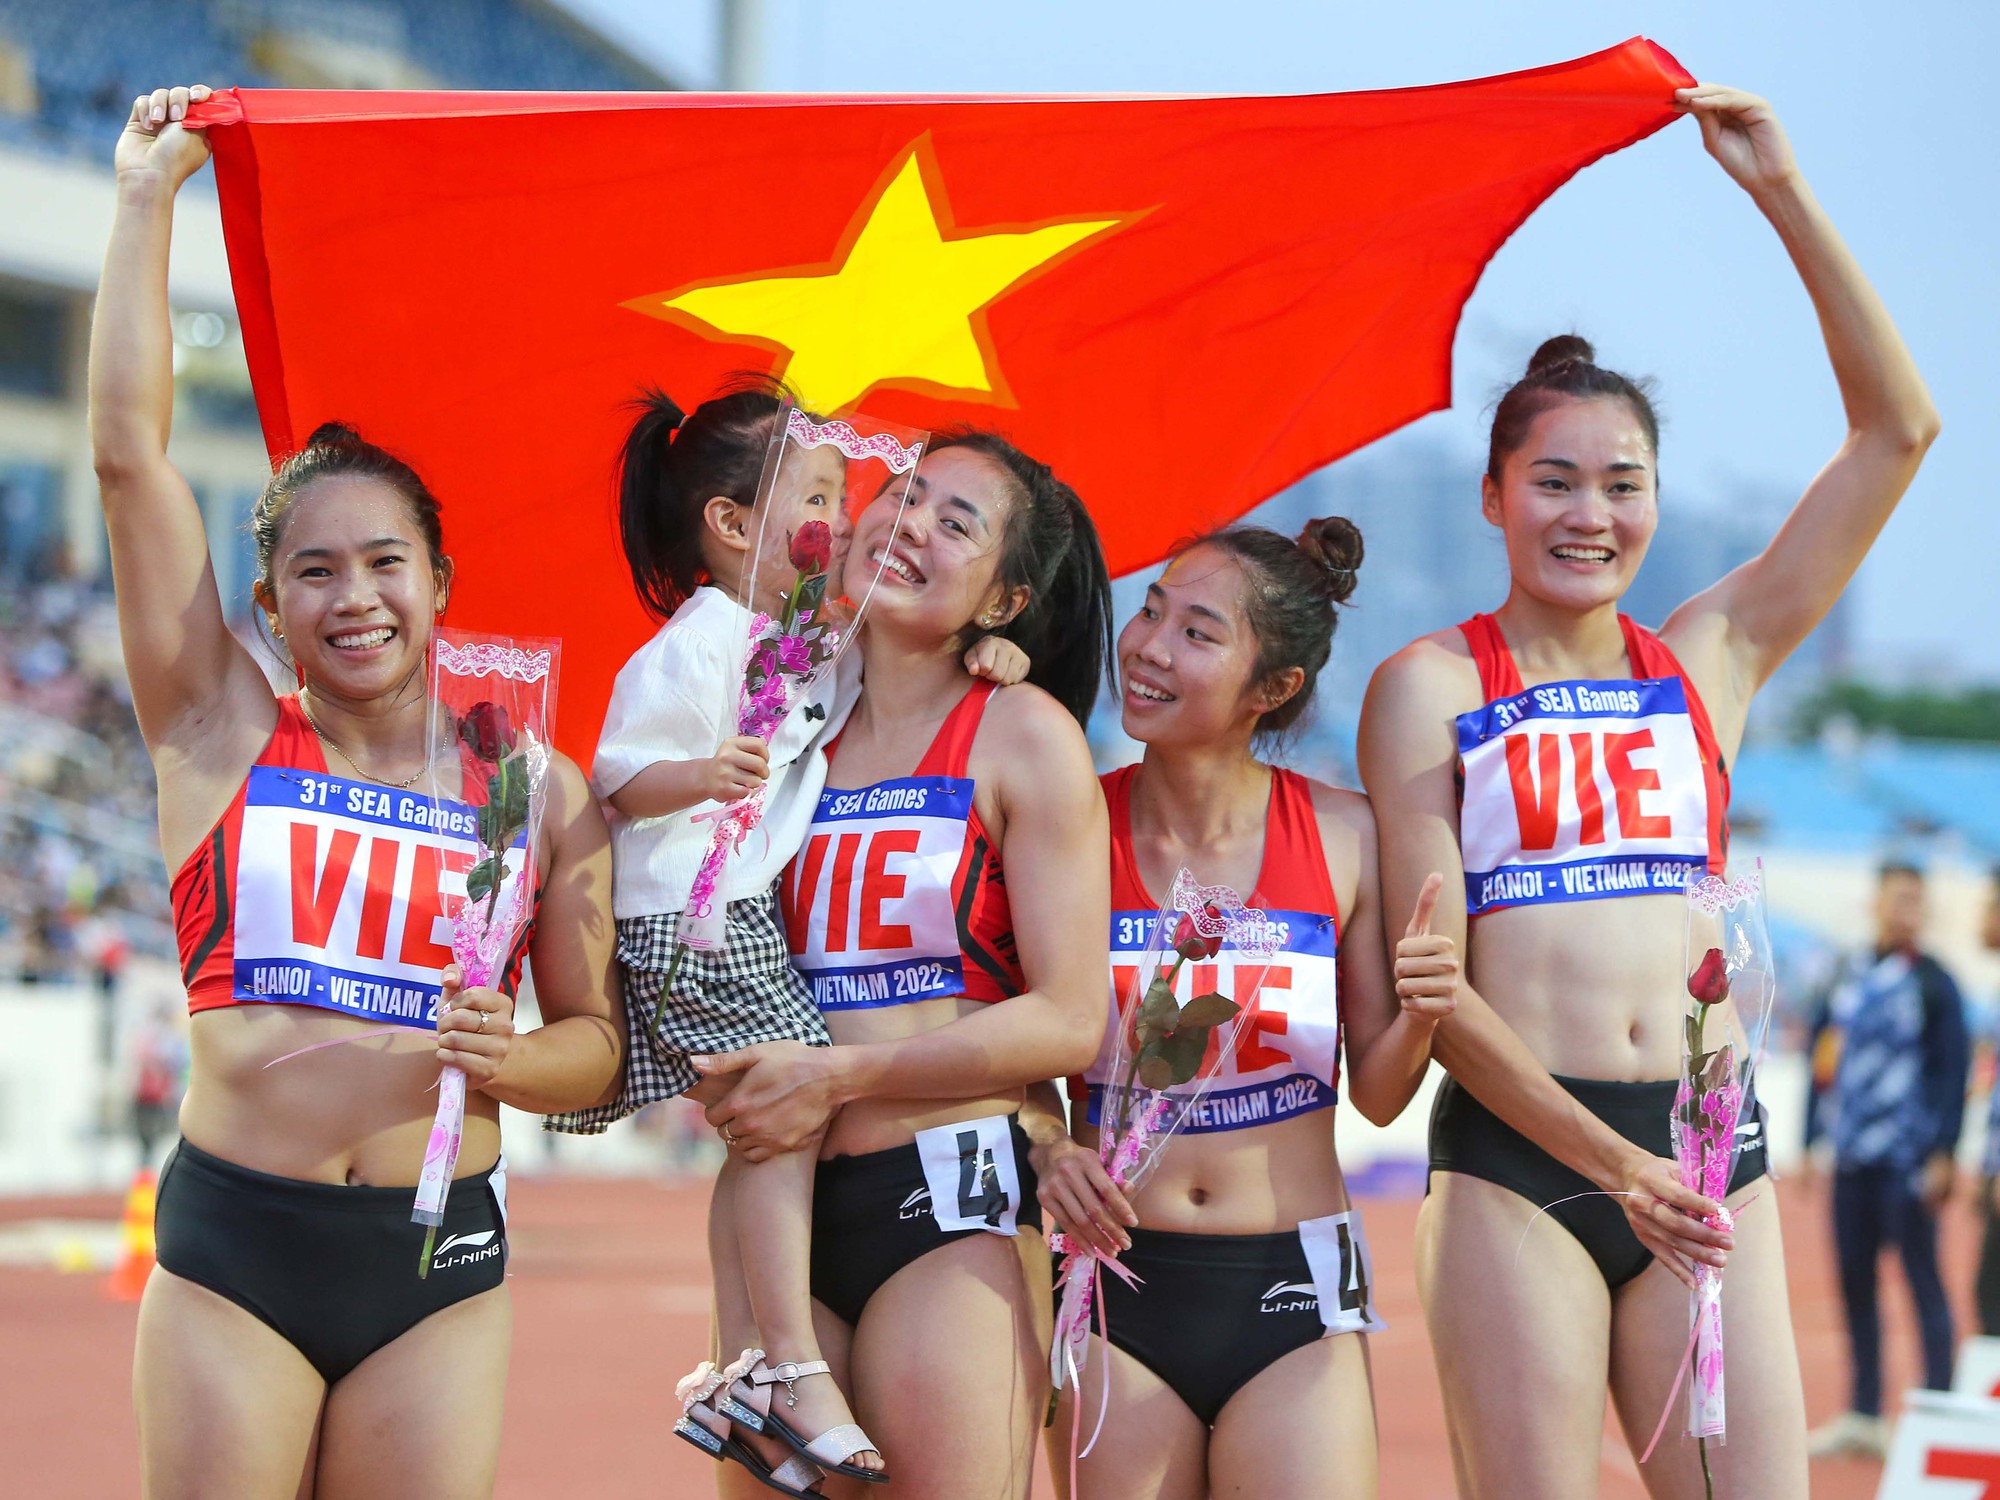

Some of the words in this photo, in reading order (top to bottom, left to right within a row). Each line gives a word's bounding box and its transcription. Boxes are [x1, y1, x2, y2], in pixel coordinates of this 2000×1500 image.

[1533, 687, 1576, 713] SEA
[1576, 686, 1641, 713] Games
[346, 787, 391, 819] SEA
[398, 797, 476, 835] Games
[829, 792, 866, 816] SEA
[865, 787, 928, 812] Games
[1504, 728, 1672, 850] VIE
[290, 822, 478, 970] VIE
[780, 830, 921, 955] VIE
[1482, 872, 1544, 904] HANOI
[1561, 862, 1650, 894] VIETNAM
[1651, 862, 1696, 888] 2022
[254, 967, 311, 997] HANOI
[330, 976, 421, 1020] VIETNAM
[814, 972, 889, 1004] VIETNAM
[893, 963, 945, 995] 2022
[1178, 1093, 1270, 1127] VIETNAM
[1274, 1079, 1319, 1119] 2022
[956, 1129, 1009, 1228] 4
[433, 1243, 500, 1269] LI-NING
[1336, 1222, 1373, 1324] 4
